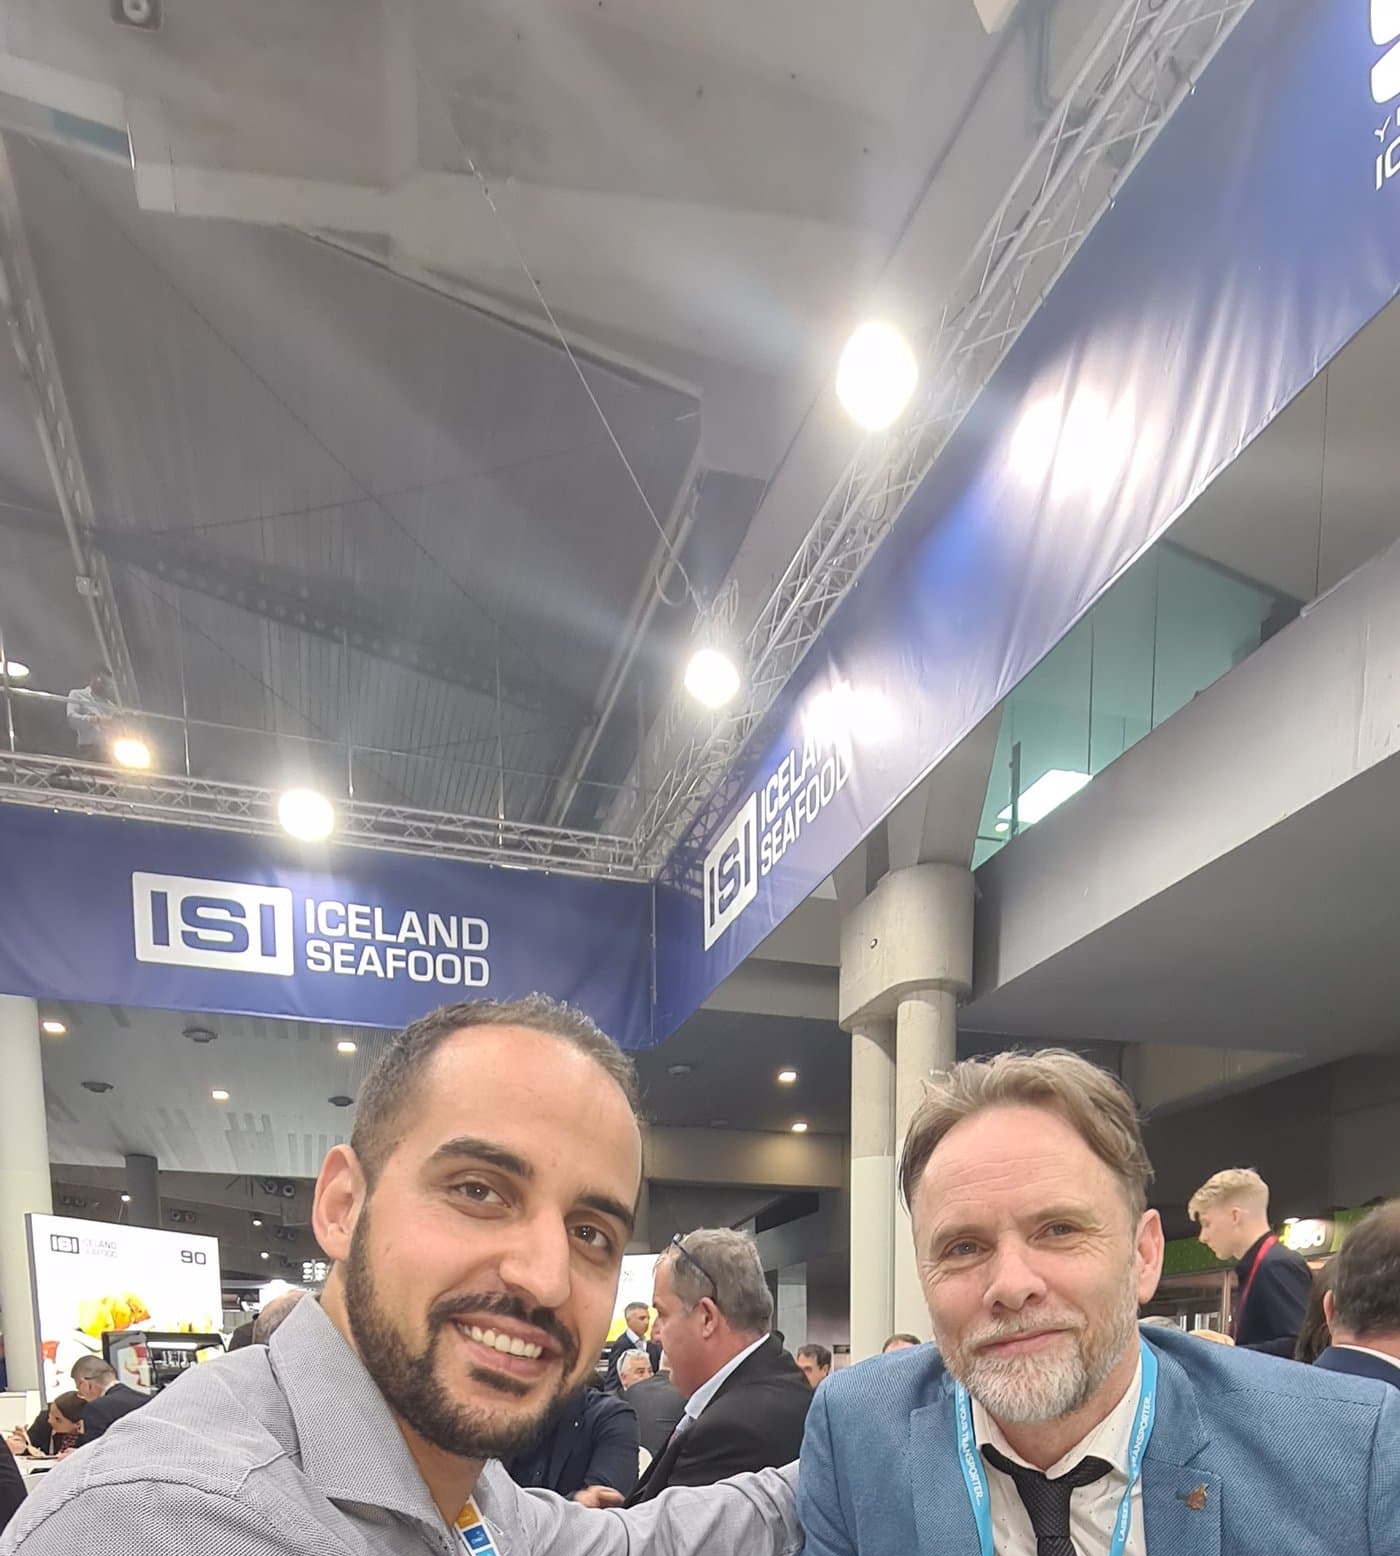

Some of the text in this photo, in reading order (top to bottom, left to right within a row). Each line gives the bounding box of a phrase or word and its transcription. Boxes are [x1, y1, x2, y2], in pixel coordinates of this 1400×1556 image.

[761, 746, 852, 876] SEAFOOD
[148, 887, 280, 960] ISI
[304, 897, 491, 952] ICELAND
[305, 939, 491, 988] SEAFOOD
[181, 1250, 207, 1265] 90
